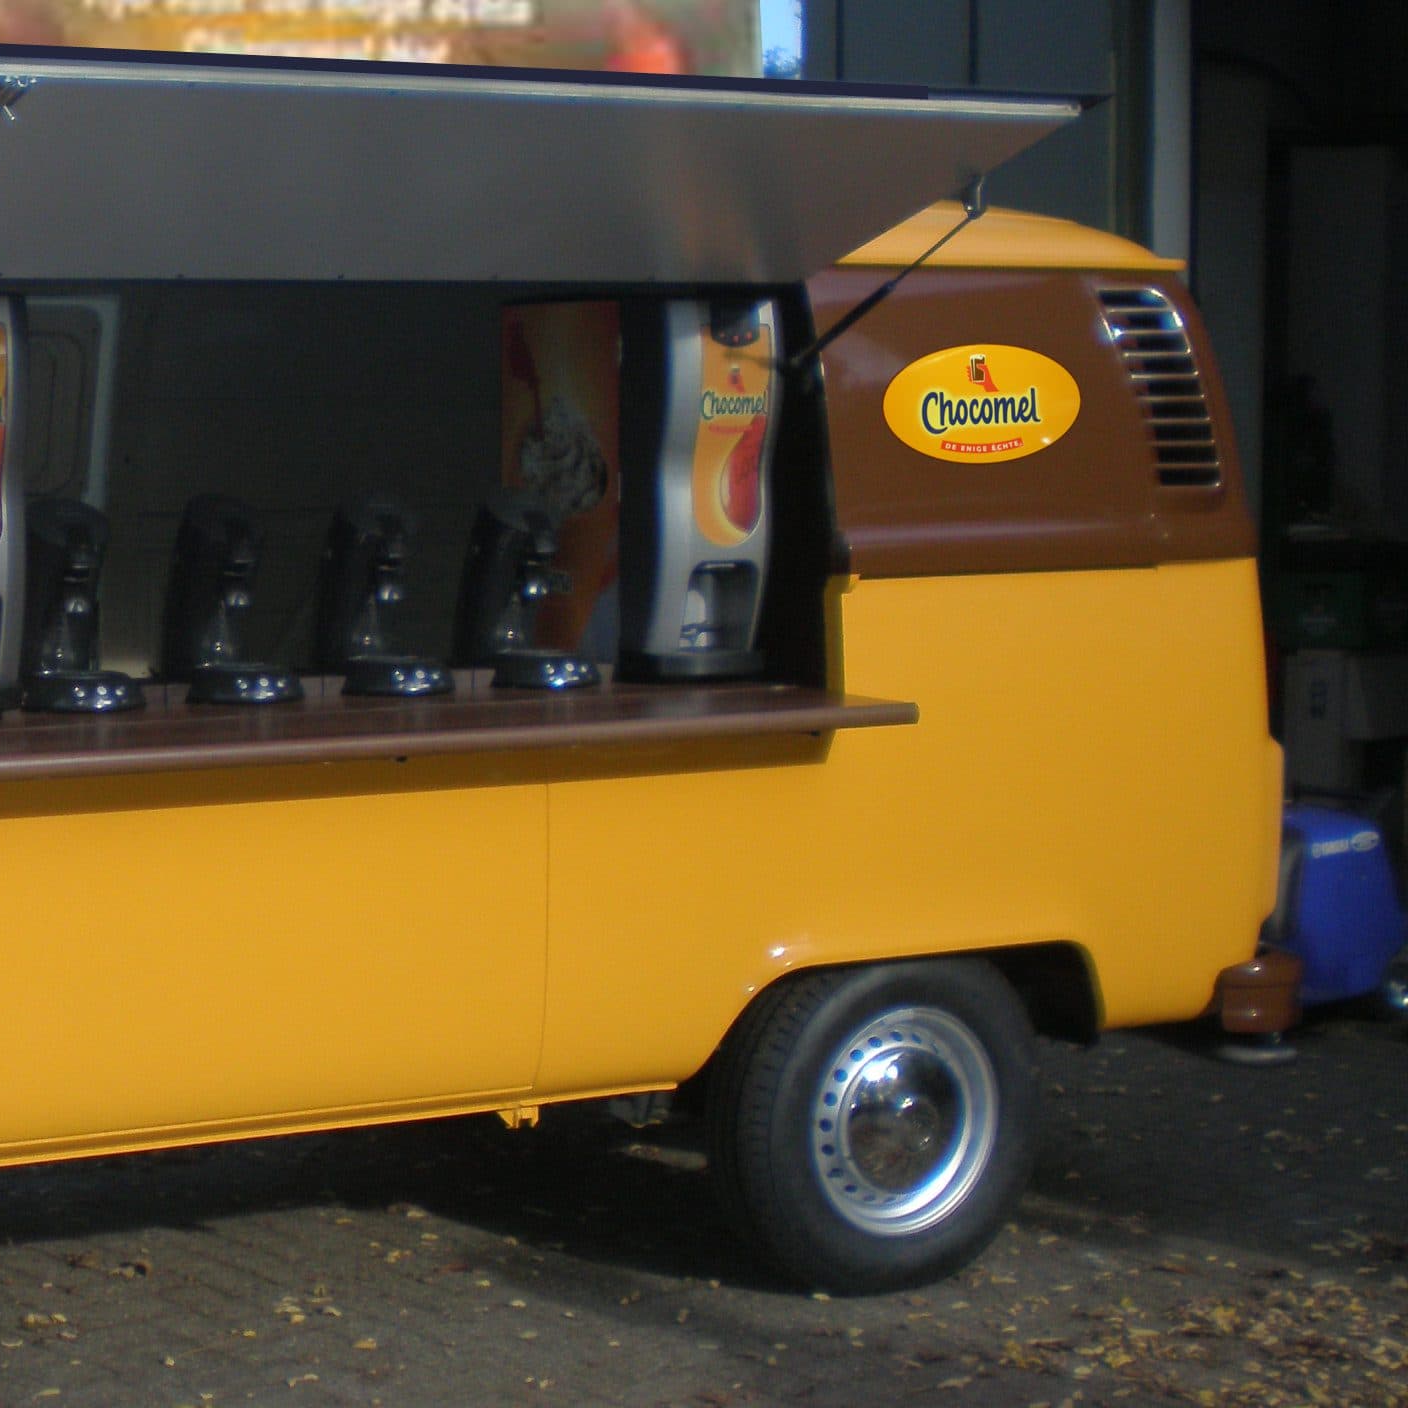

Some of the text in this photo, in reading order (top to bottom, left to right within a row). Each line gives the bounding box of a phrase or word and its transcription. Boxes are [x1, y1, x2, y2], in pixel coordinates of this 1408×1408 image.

[702, 390, 768, 420] Chocomel
[921, 387, 1041, 435] Chocomel
[945, 442, 957, 450] DE
